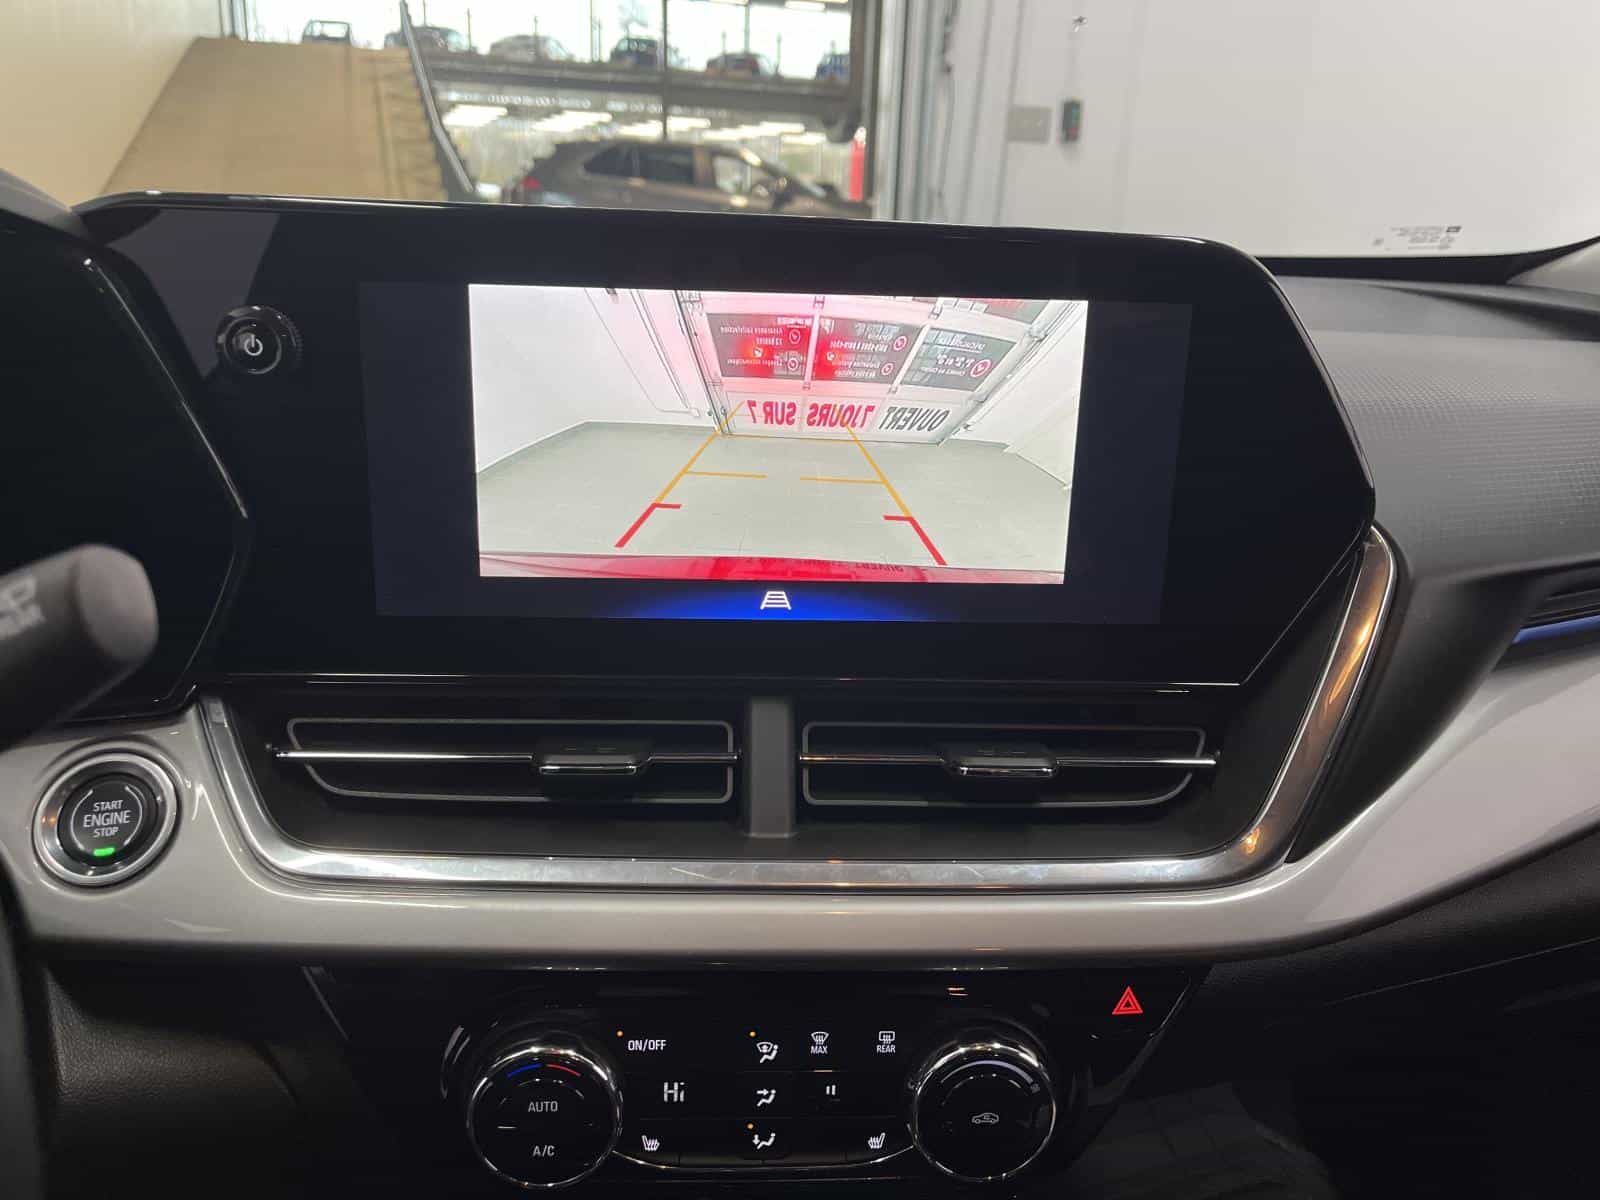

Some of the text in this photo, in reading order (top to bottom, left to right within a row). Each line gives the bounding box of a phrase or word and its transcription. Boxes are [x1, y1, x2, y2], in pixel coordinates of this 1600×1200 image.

[93, 800, 123, 812] START
[83, 810, 131, 828] ENGINE
[93, 826, 119, 838] STOP
[627, 1039, 667, 1052] ON/OFF
[810, 1045, 828, 1054] MAX
[876, 1044, 896, 1053] REAR
[663, 1081, 685, 1102] Hi
[528, 1100, 559, 1112] AUTO
[532, 1144, 555, 1157] A/C
